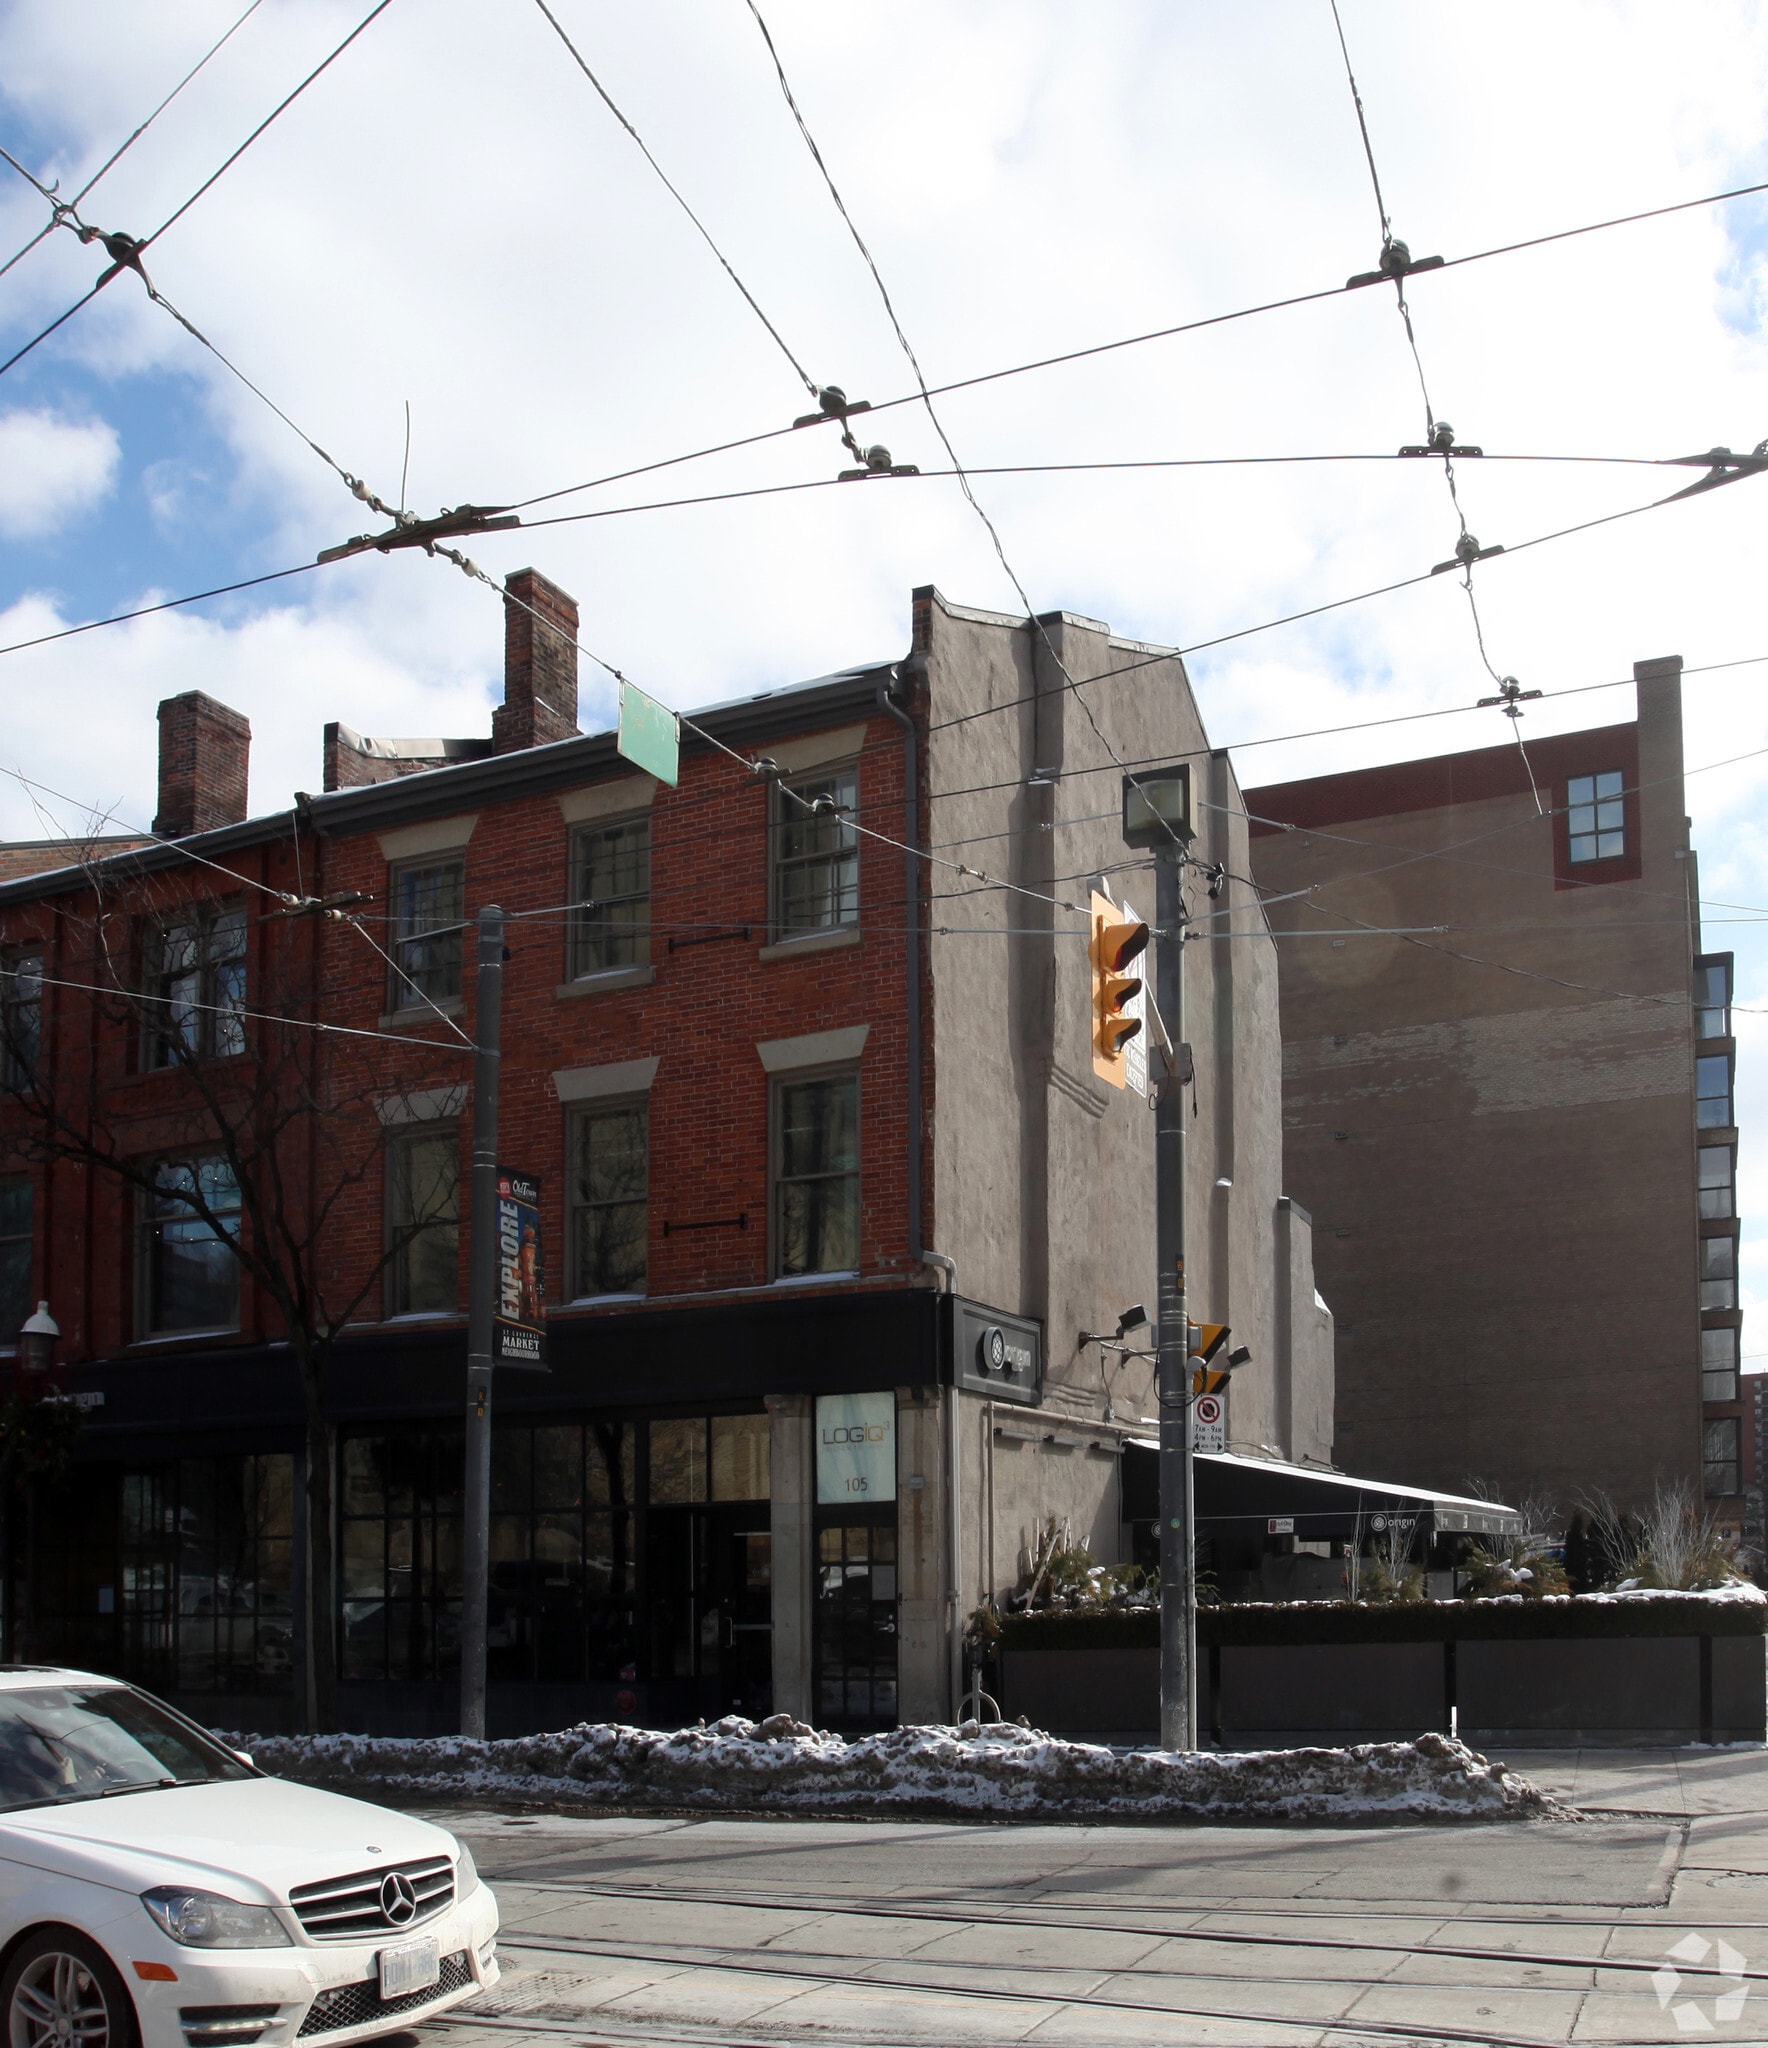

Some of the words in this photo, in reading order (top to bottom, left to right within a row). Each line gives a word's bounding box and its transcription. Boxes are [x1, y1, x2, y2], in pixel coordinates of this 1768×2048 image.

[500, 1199, 519, 1321] EXPLORE
[502, 1335, 540, 1351] MARKET
[844, 1477, 868, 1492] 105
[1387, 1518, 1416, 1530] origin
